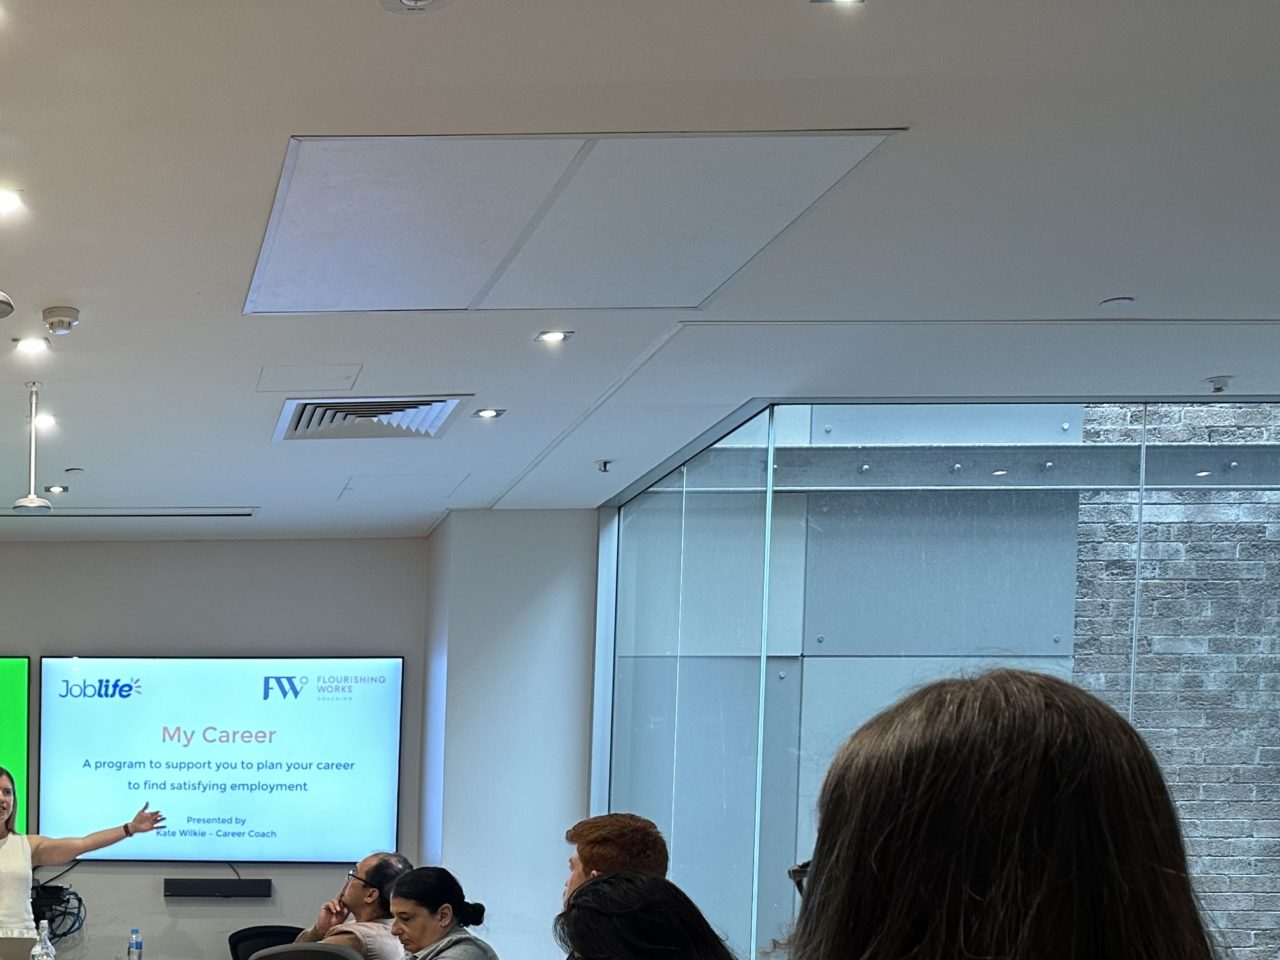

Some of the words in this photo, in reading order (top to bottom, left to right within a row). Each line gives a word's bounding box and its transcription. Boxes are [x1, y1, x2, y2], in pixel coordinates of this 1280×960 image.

[316, 675, 387, 684] FLOURISHING
[59, 678, 133, 699] Joblife
[317, 685, 353, 694] WORKS
[161, 726, 195, 748] My
[202, 726, 277, 744] Career
[83, 759, 91, 769] A
[94, 760, 146, 771] program
[149, 759, 162, 770] to
[165, 760, 212, 772] support
[215, 761, 238, 771] you
[241, 759, 254, 770] to
[257, 759, 282, 772] plan
[286, 761, 313, 772] your
[316, 760, 355, 770] career
[128, 780, 140, 790] to
[143, 780, 167, 791] find
[170, 780, 227, 792] satisfying
[230, 780, 308, 792] employment
[186, 816, 232, 825] Presented
[234, 816, 246, 826] by
[156, 829, 177, 837] Kate
[179, 829, 207, 837] Wilkie
[215, 829, 246, 838] Career
[248, 830, 277, 838] Coach
